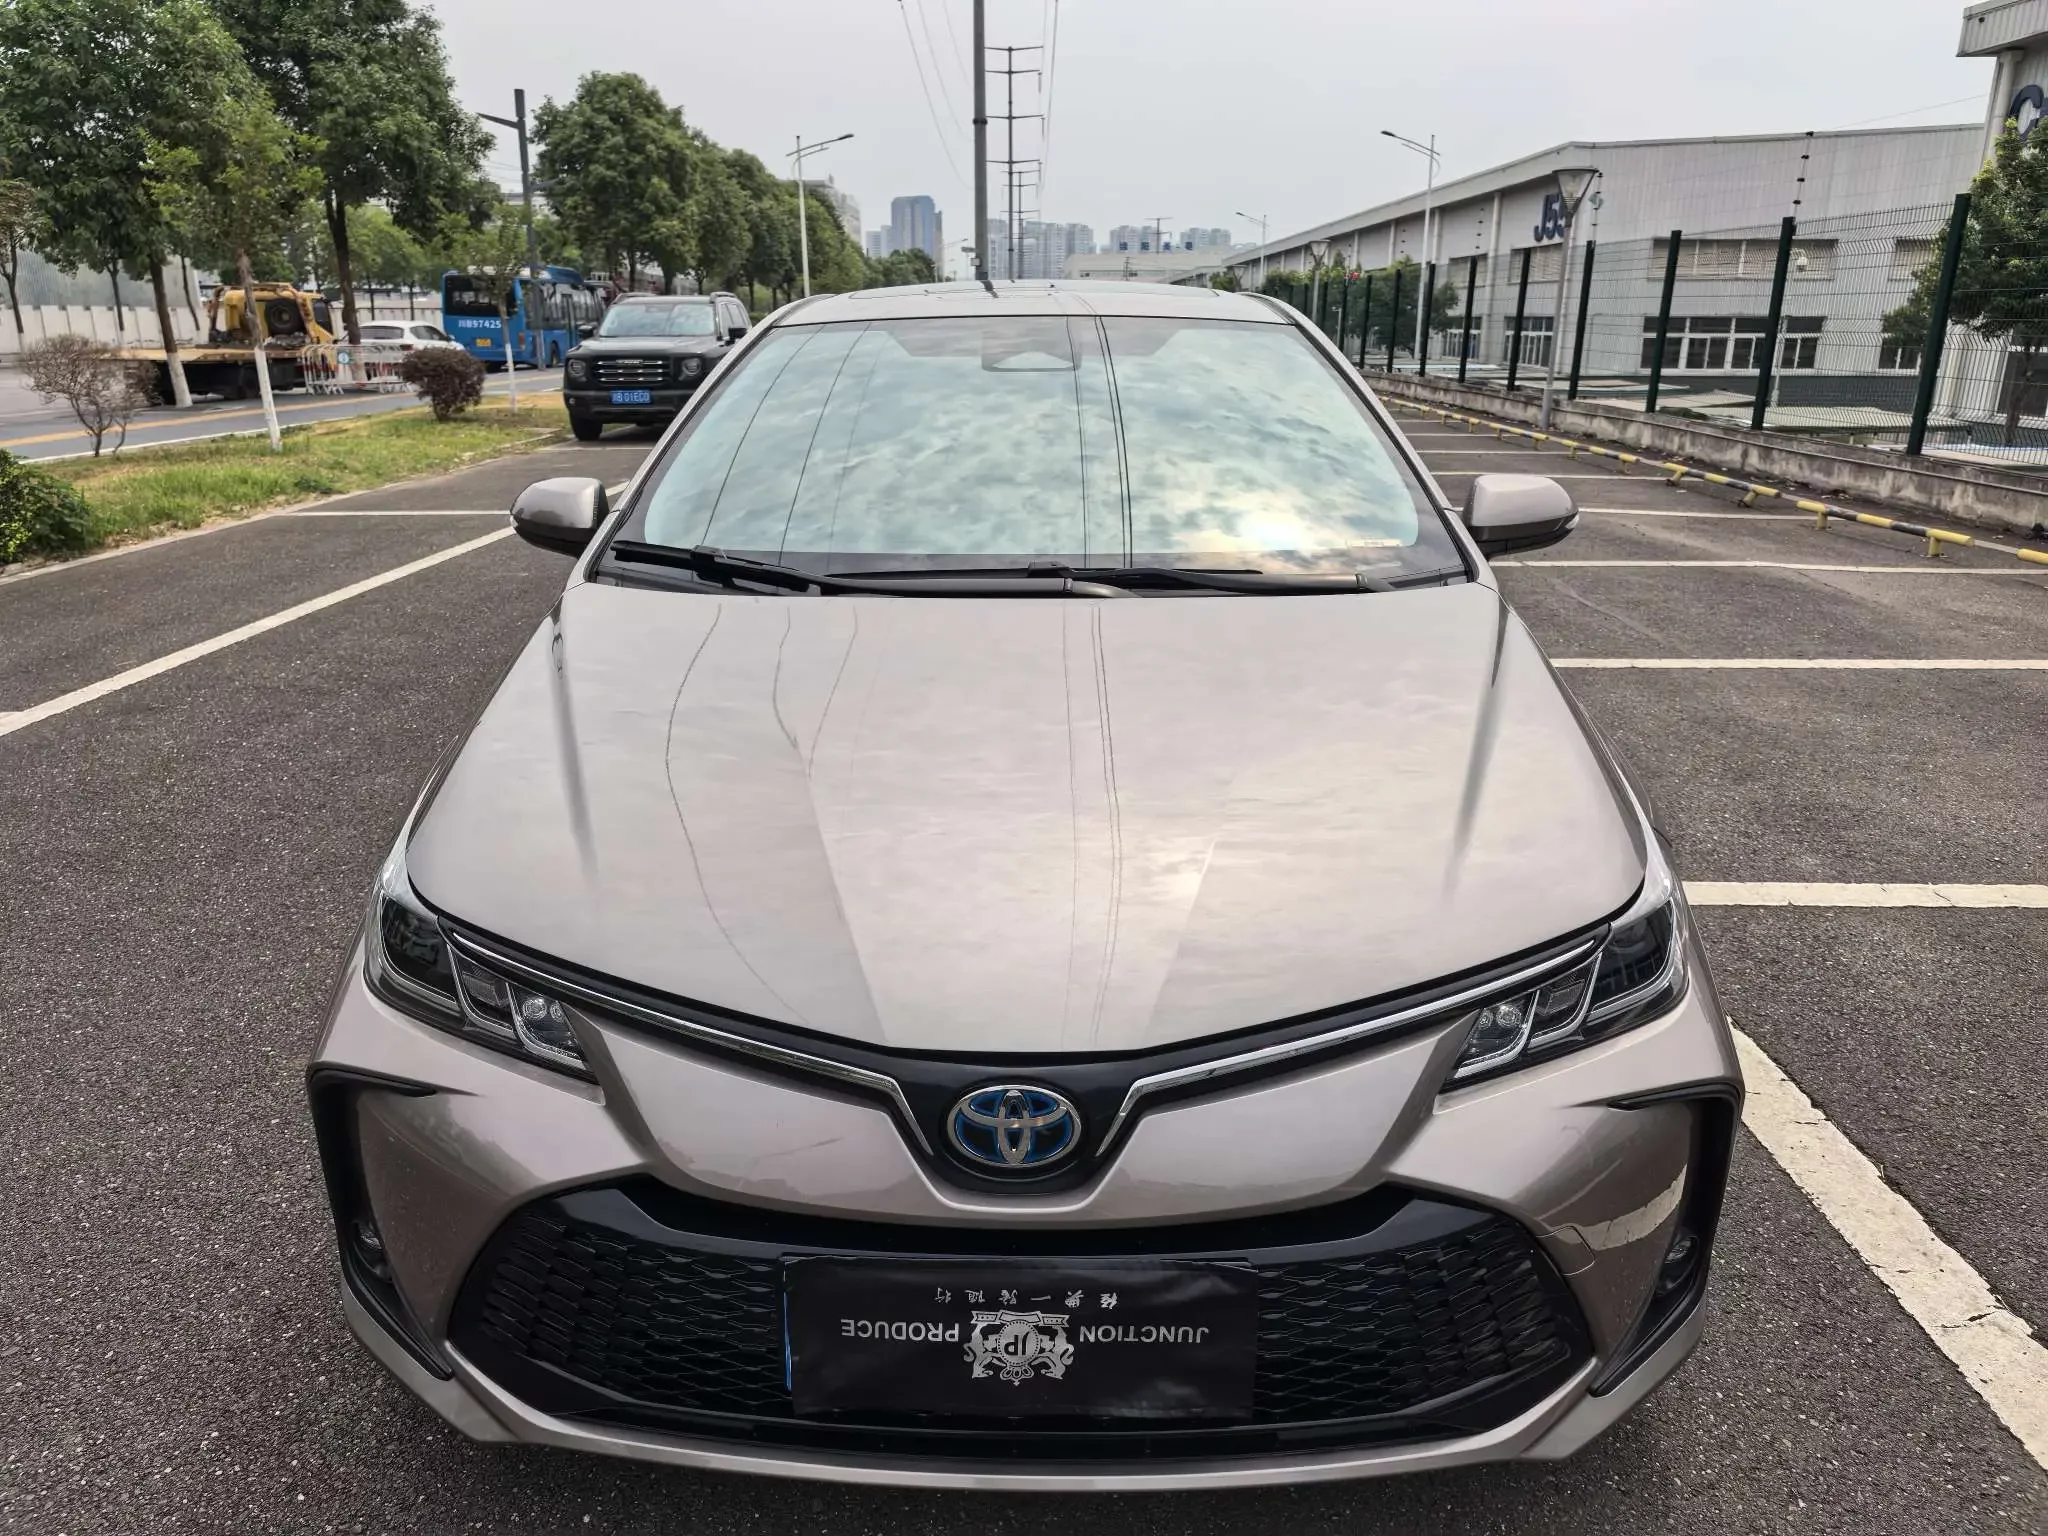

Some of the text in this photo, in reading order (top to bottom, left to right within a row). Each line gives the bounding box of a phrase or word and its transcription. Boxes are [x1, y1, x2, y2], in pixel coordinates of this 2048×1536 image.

[935, 1287, 1118, 1309] 经典一路随行
[841, 1318, 1209, 1343] JUNCTION PRODUCE
[1003, 1330, 1031, 1356] JP
